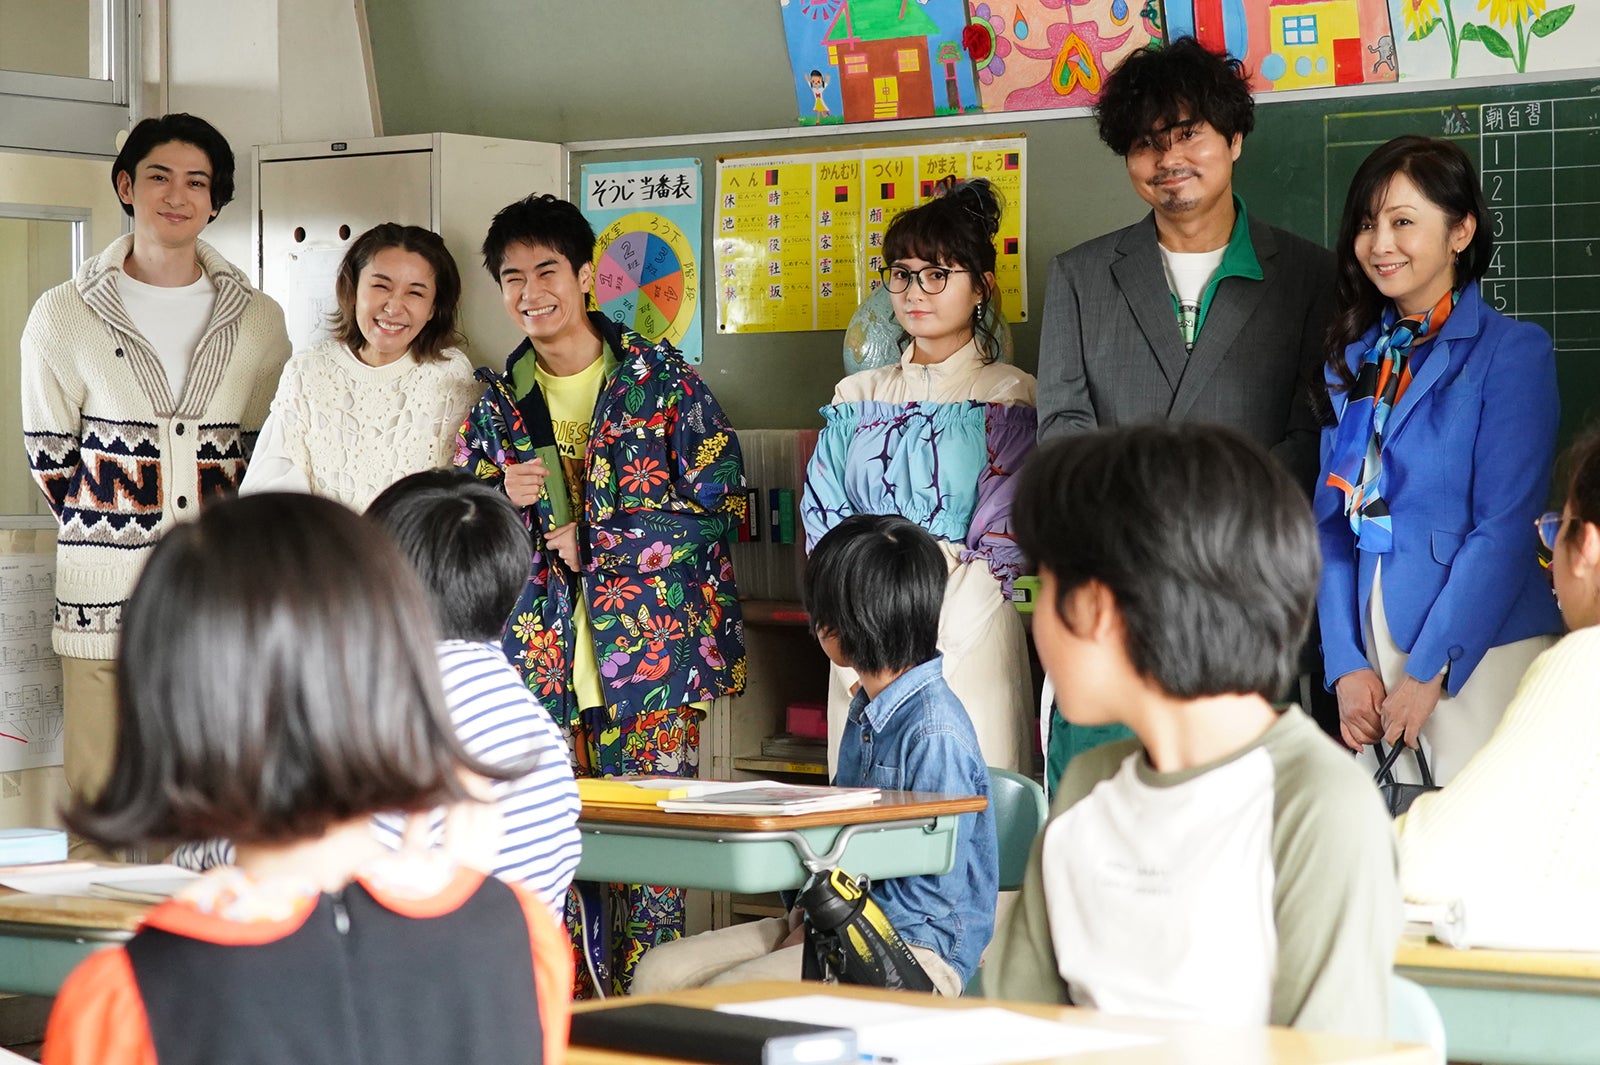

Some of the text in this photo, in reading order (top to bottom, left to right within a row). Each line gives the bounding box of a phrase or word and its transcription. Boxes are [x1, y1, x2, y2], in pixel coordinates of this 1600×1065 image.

[1485, 102, 1541, 131] 朝自習
[873, 161, 904, 177] つくり
[927, 156, 958, 174] かまえ
[972, 153, 1004, 171] にょう
[729, 172, 758, 187] へん
[820, 163, 859, 180] かんむり
[591, 174, 693, 207] そうじ当番表
[1491, 175, 1503, 201] 2
[724, 194, 735, 208] 休
[768, 190, 781, 206] 時
[768, 214, 780, 229] 持
[819, 211, 831, 226] 草
[869, 207, 882, 223] 顔
[722, 217, 735, 231] 池
[1493, 211, 1504, 238] 3
[768, 238, 780, 252] 役
[820, 234, 831, 249] 客
[869, 232, 882, 246] 数
[819, 258, 831, 274] 雲
[1488, 245, 1506, 276] 4
[768, 262, 781, 276] 社
[768, 285, 782, 299] 坂
[820, 282, 832, 297] 答
[1493, 282, 1507, 311] 5
